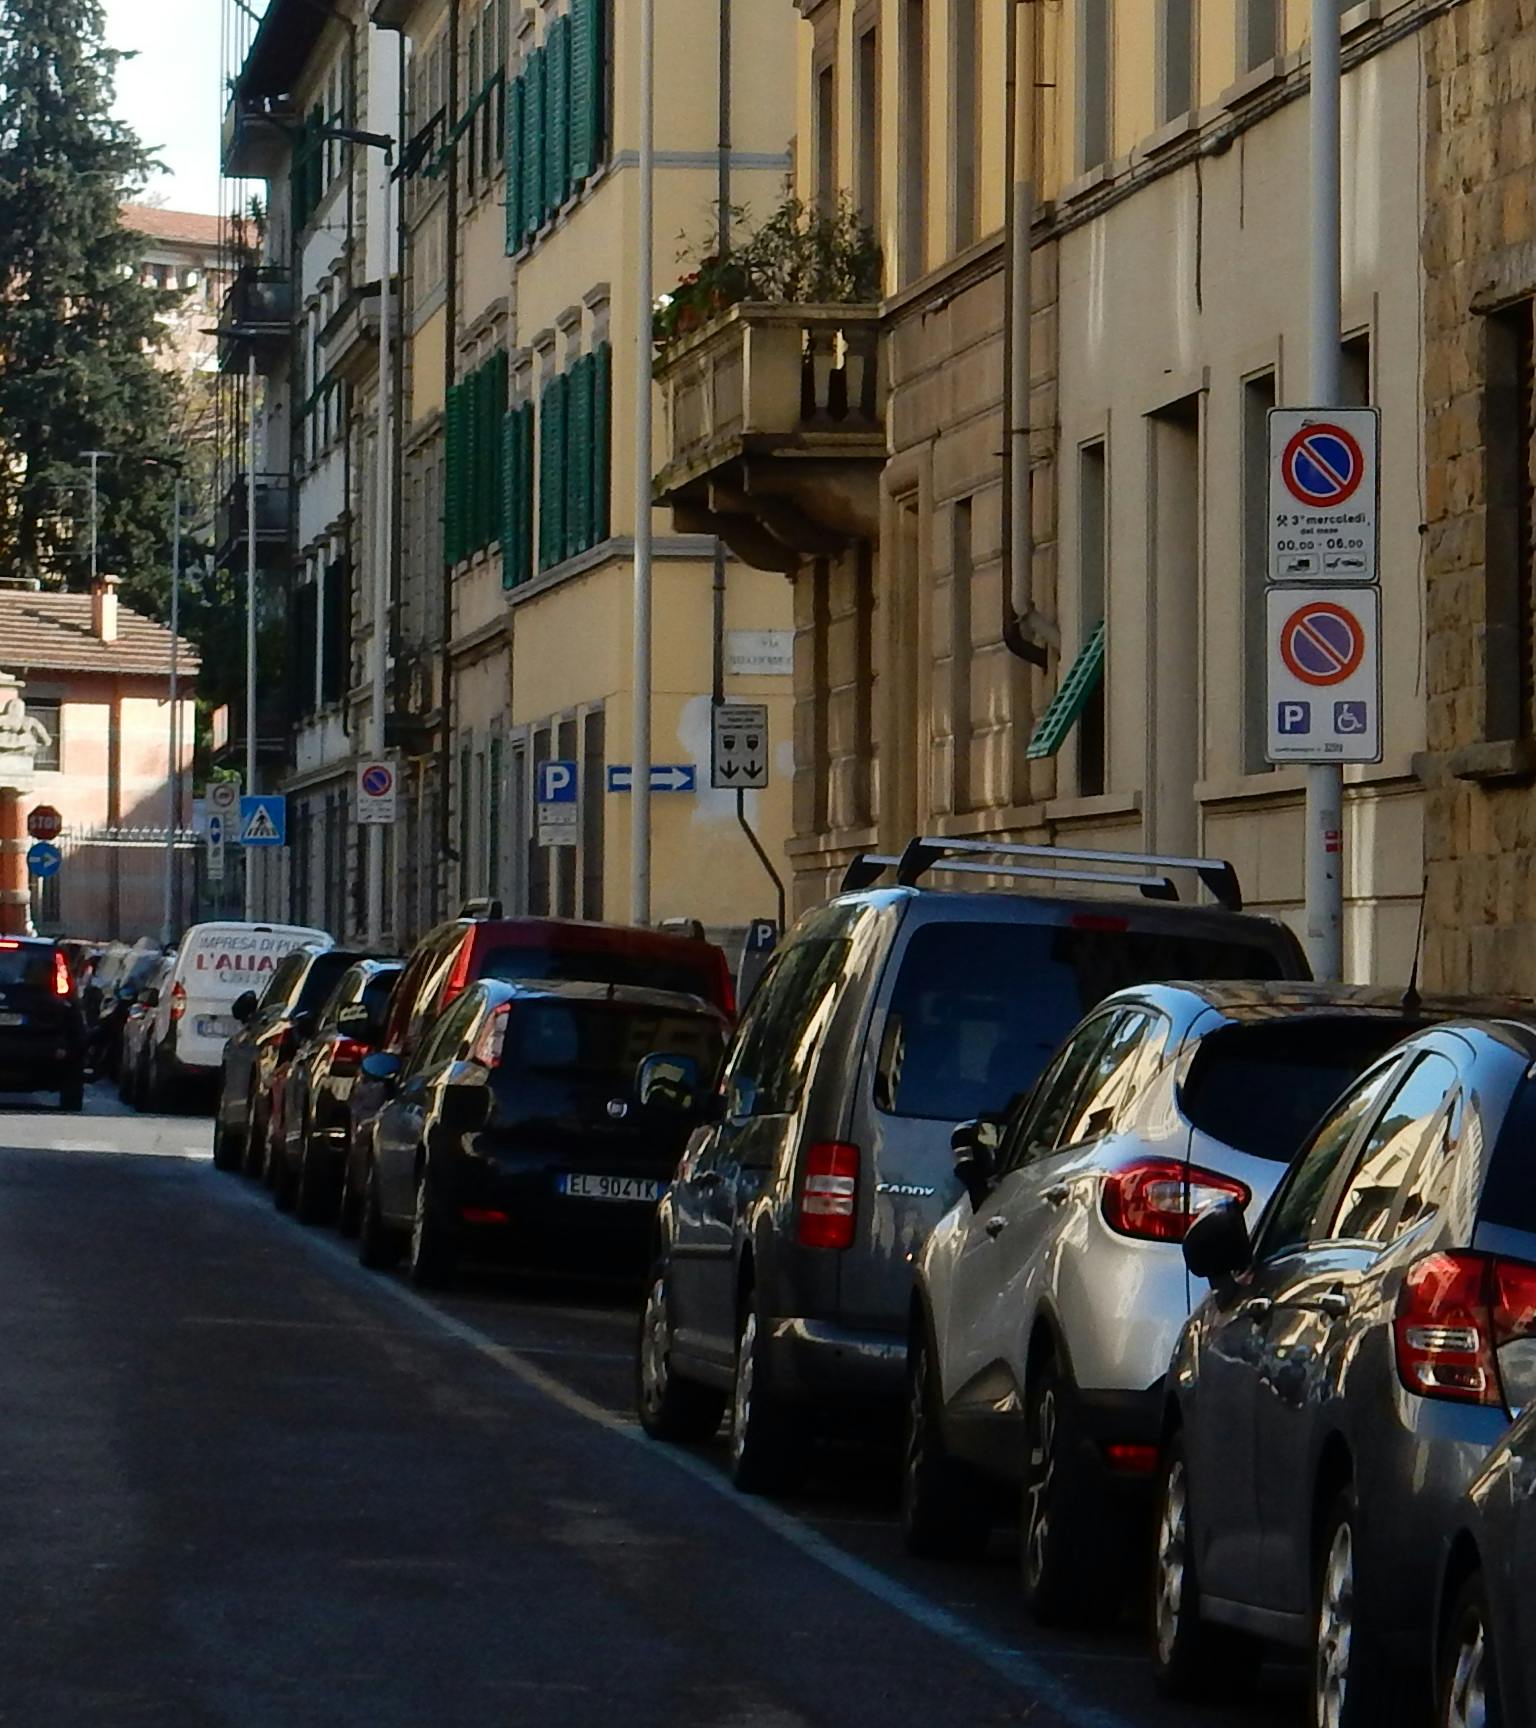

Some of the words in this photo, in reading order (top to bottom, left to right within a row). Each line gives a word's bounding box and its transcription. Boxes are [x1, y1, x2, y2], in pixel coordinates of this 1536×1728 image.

[1284, 705, 1304, 731] P
[545, 765, 571, 800] P
[29, 815, 60, 829] STOP
[757, 924, 773, 947] P
